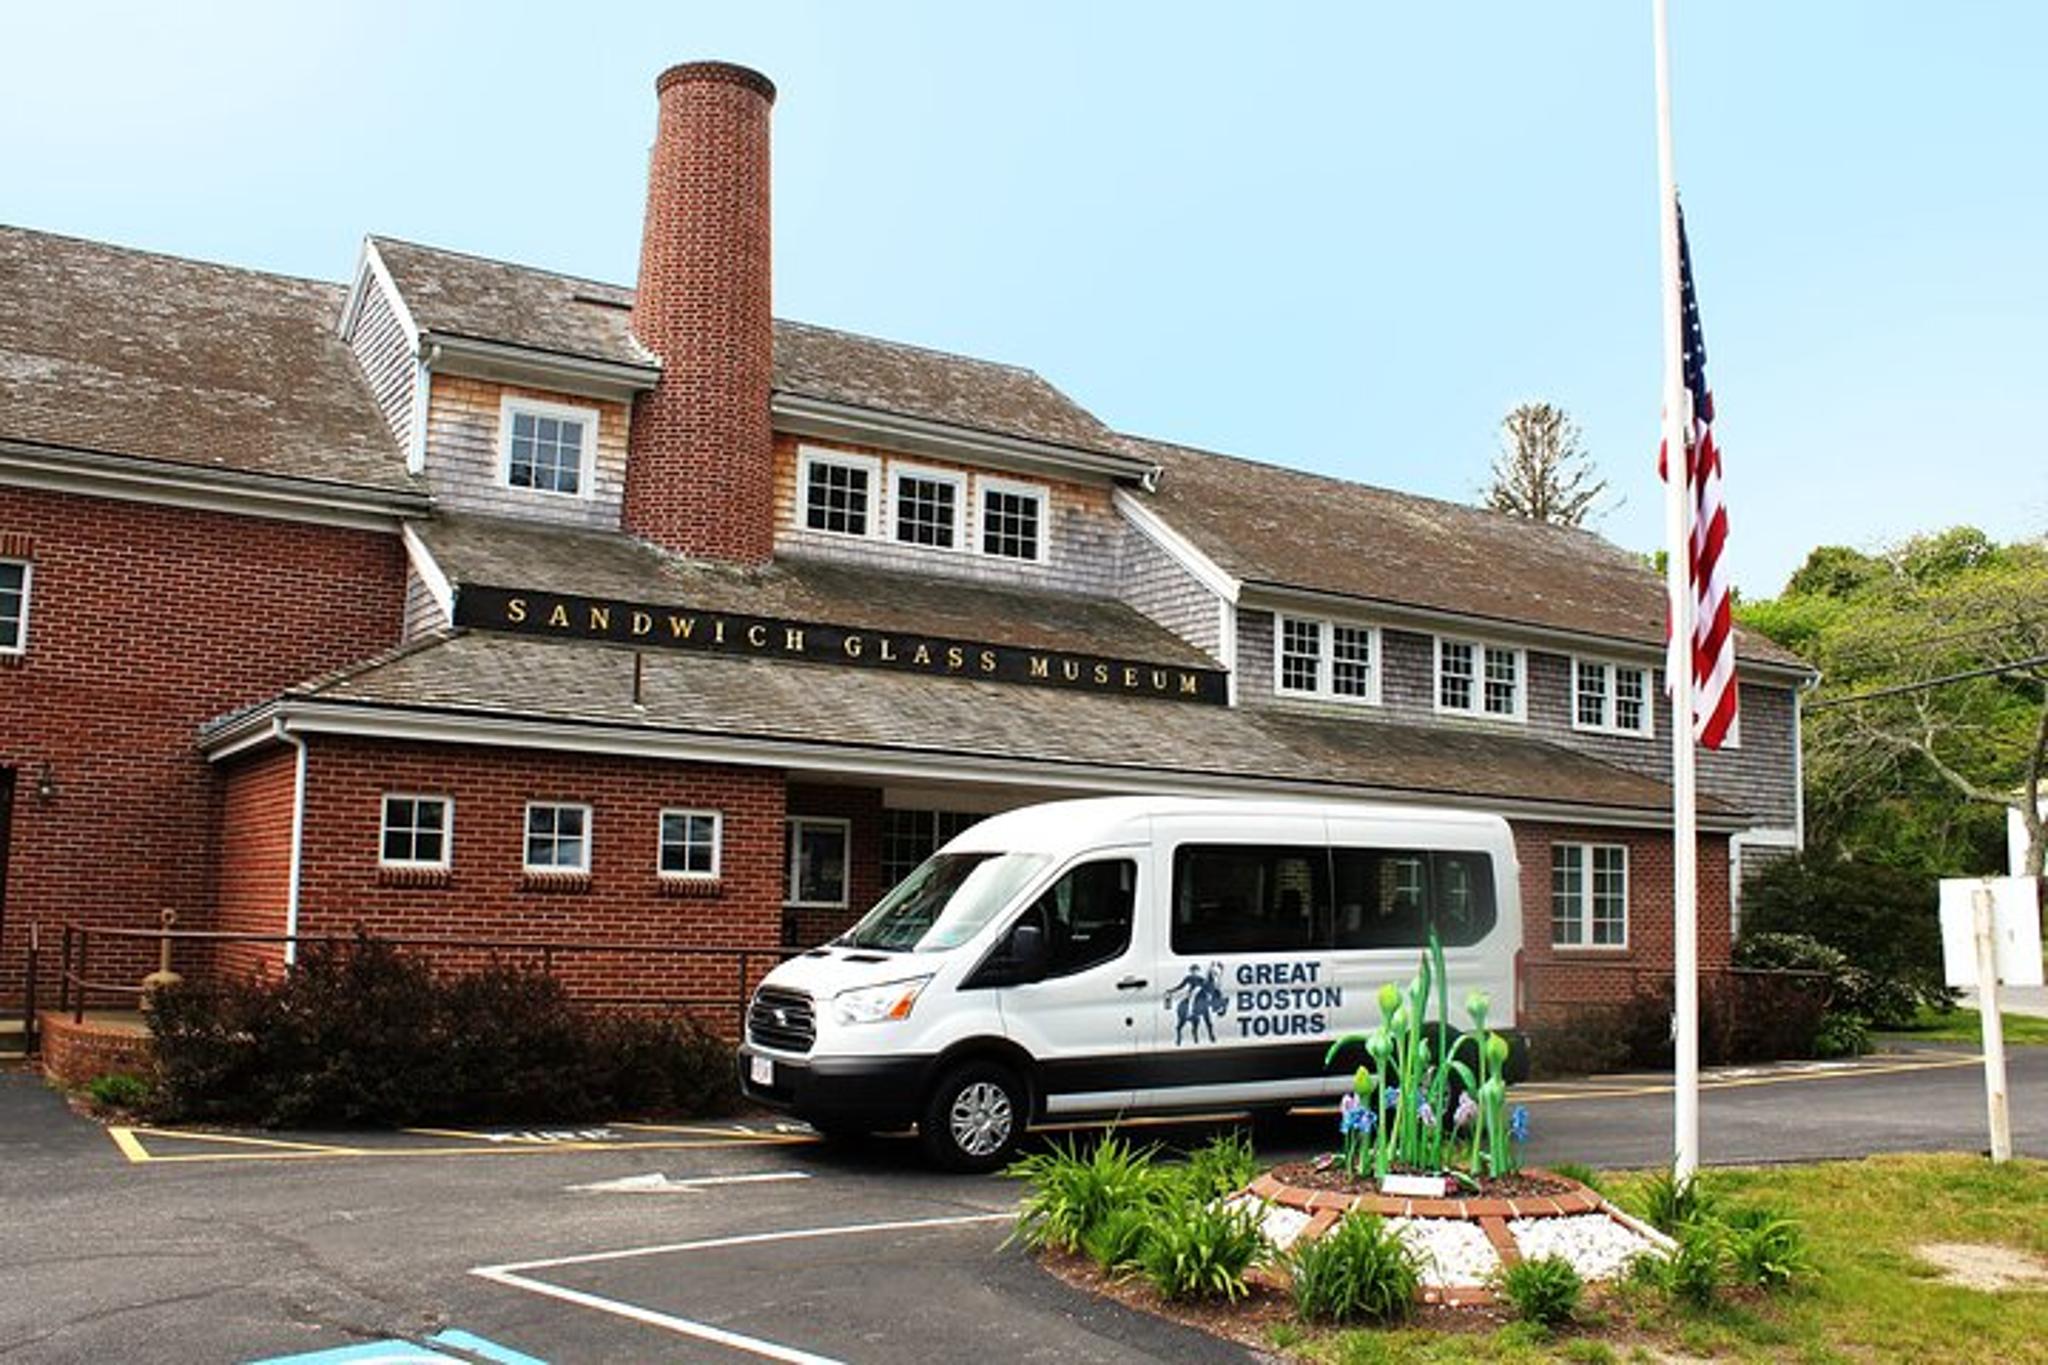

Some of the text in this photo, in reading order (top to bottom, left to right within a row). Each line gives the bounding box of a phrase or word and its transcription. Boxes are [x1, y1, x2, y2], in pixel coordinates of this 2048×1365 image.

[508, 599, 1200, 693] SANDWICH GLASS MUSEUM
[1237, 963, 1320, 985] GREAT
[1237, 987, 1341, 1011] BOSTON
[1237, 1015, 1325, 1036] TOURS
